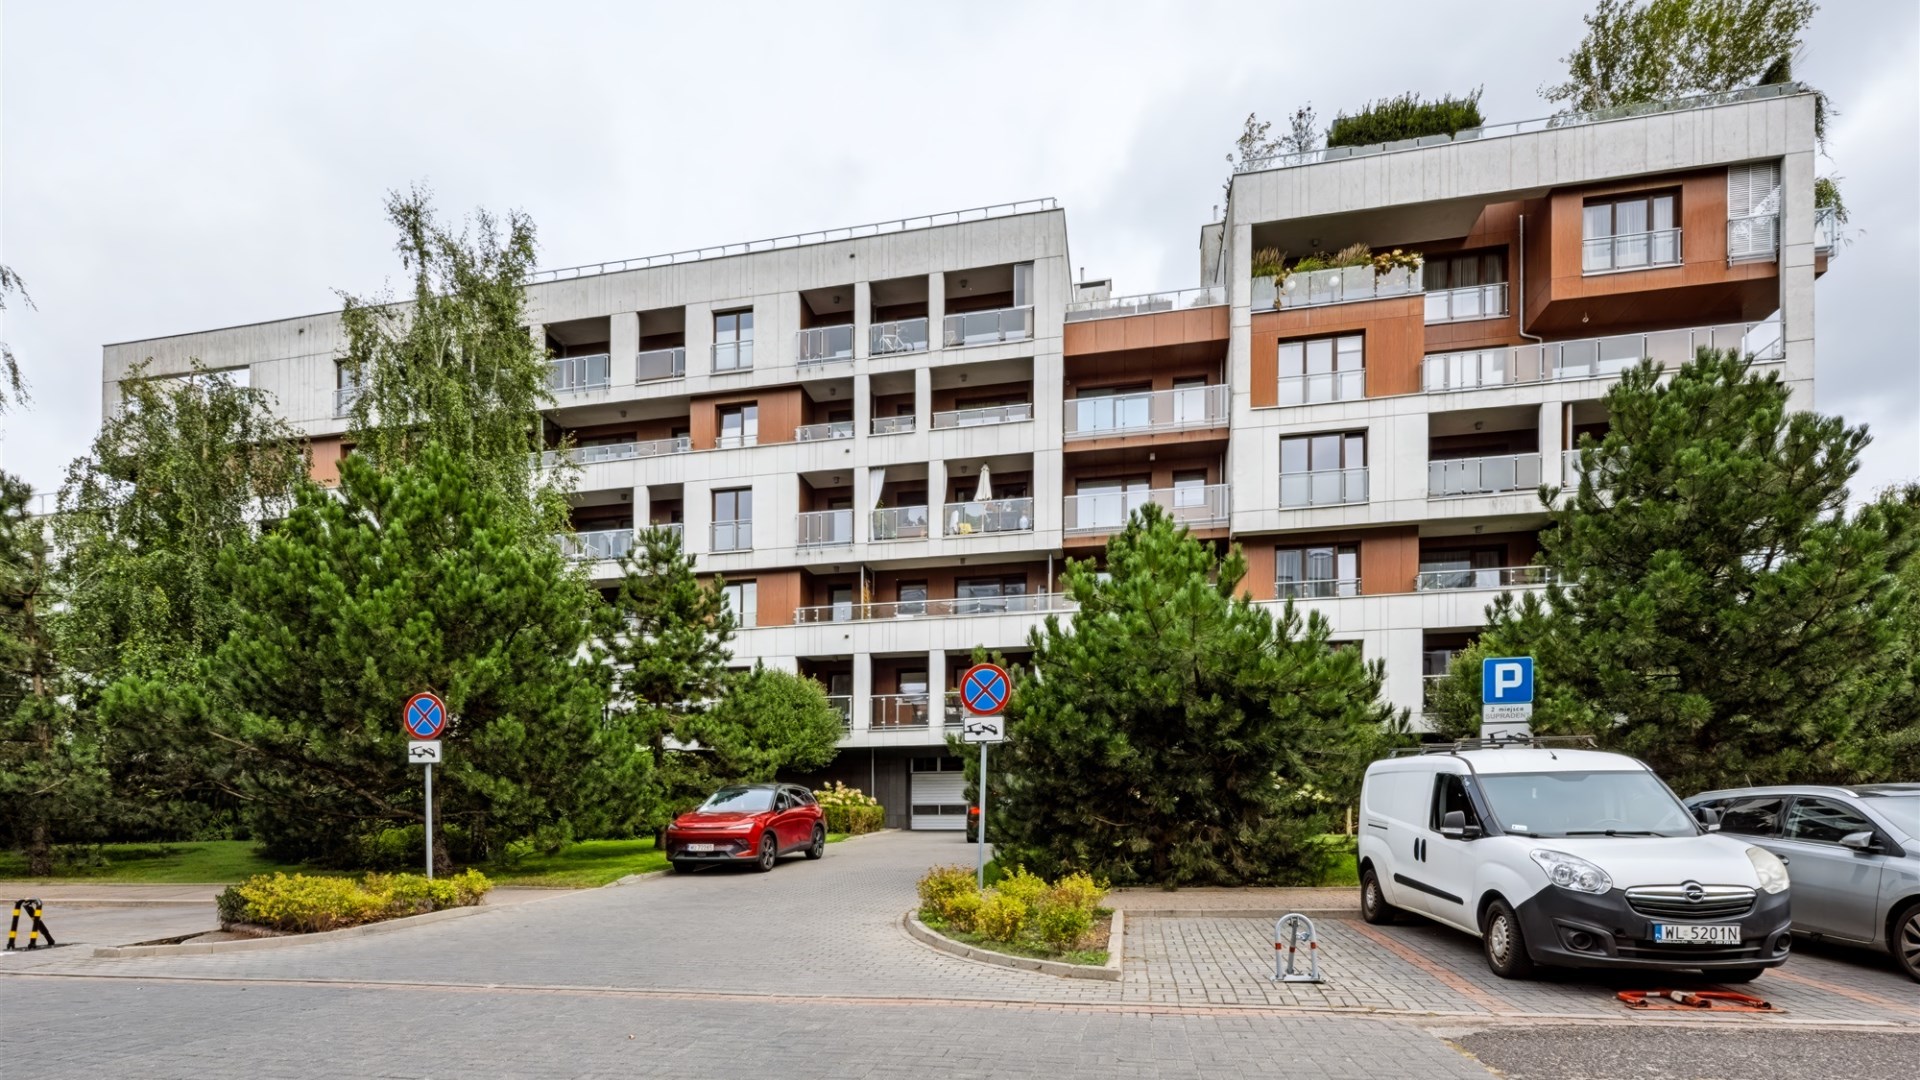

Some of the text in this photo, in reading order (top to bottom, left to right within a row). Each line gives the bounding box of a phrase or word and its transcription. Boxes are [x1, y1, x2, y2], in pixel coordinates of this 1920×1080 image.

[1495, 663, 1523, 698] P
[1665, 926, 1737, 940] WL 5201N
